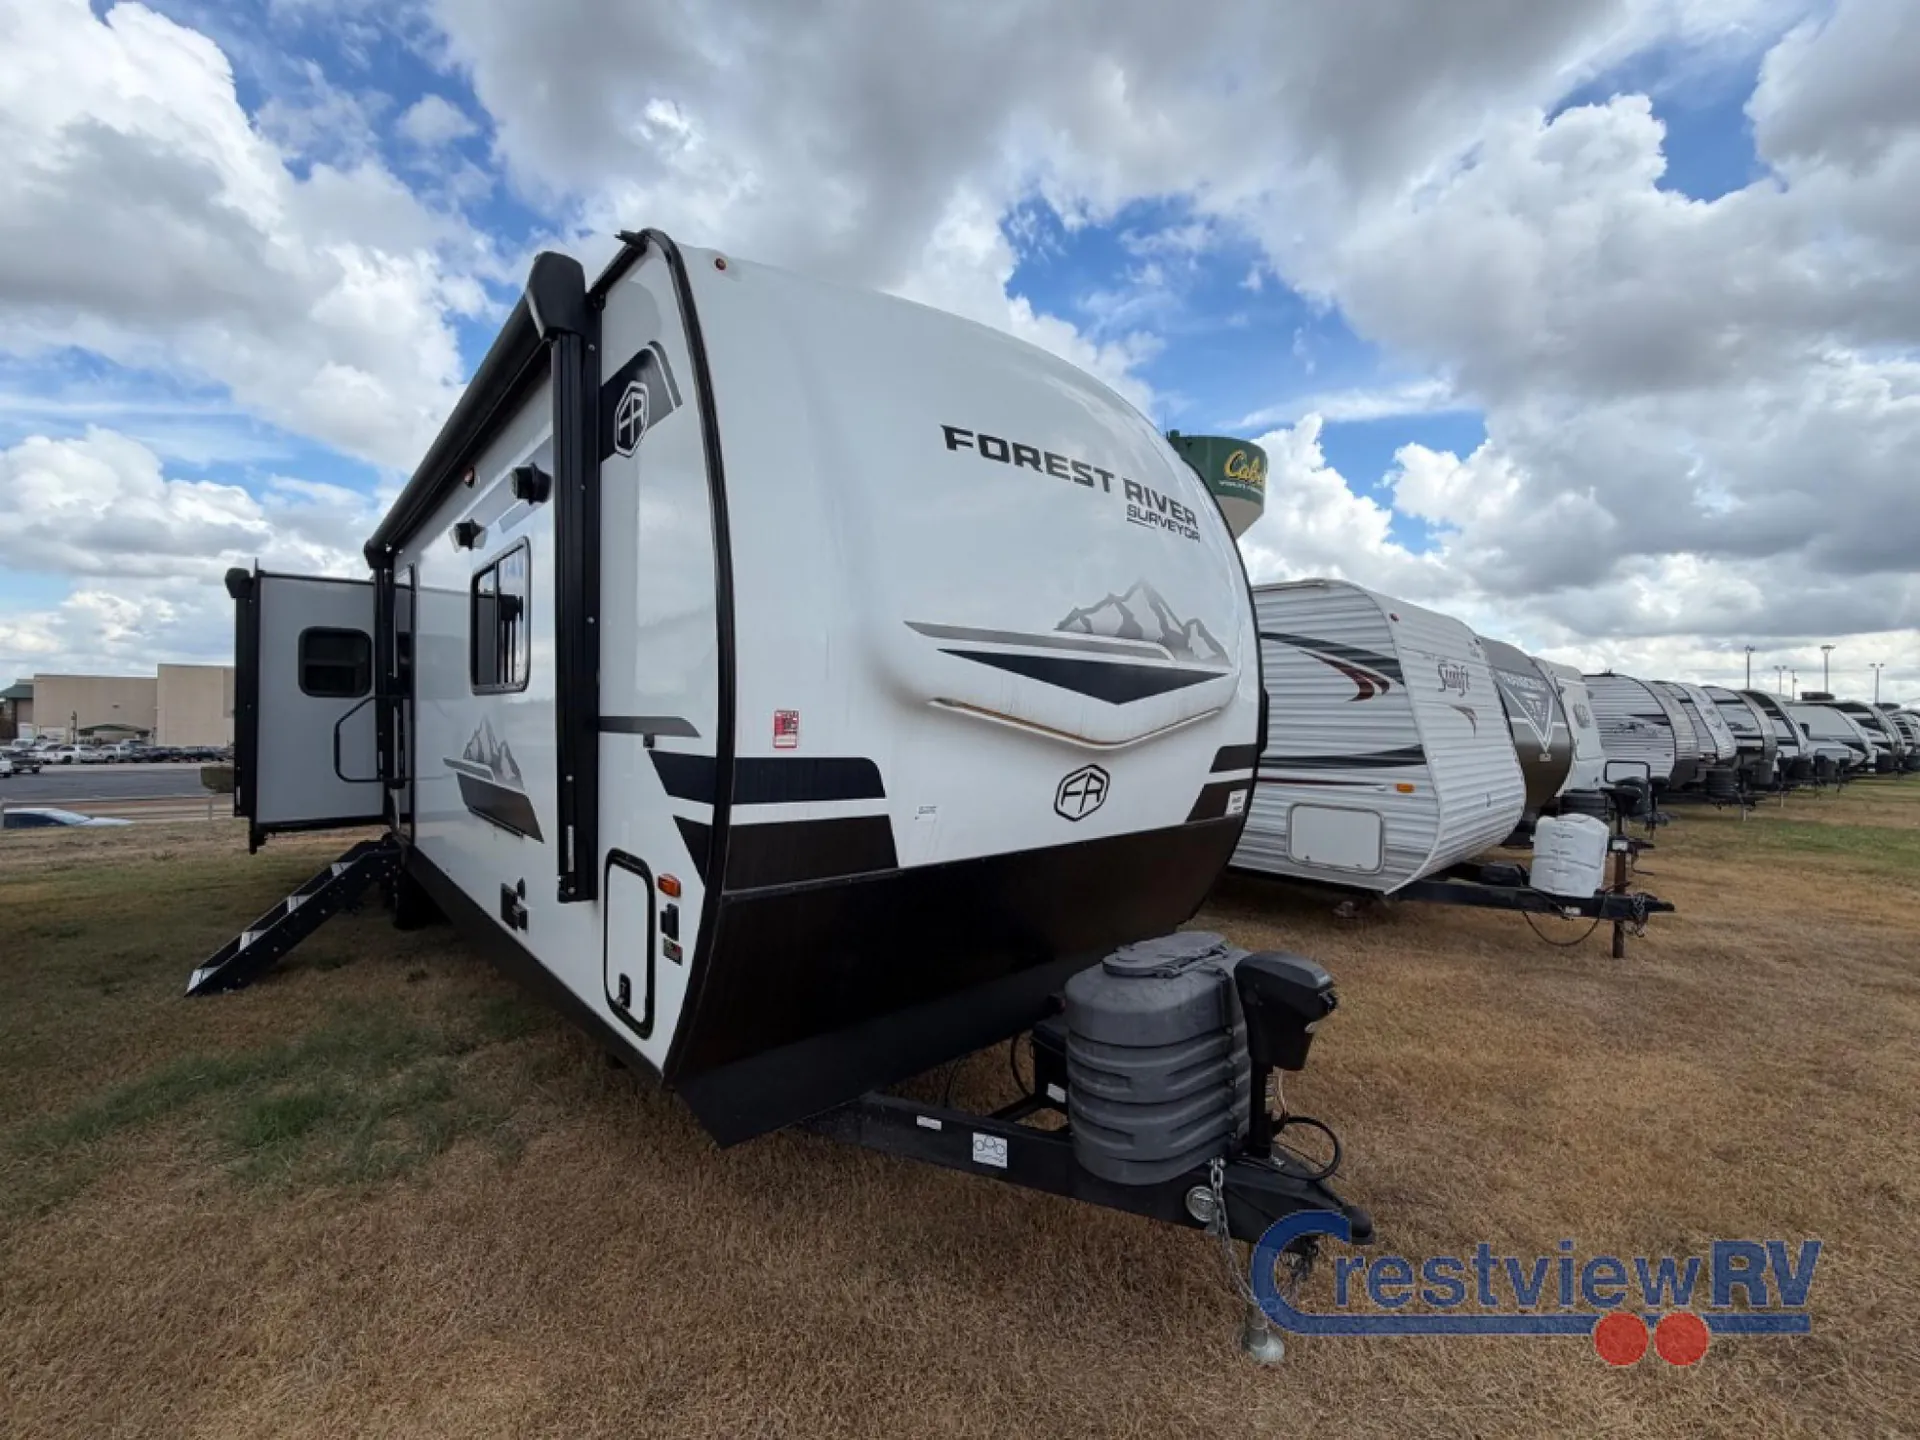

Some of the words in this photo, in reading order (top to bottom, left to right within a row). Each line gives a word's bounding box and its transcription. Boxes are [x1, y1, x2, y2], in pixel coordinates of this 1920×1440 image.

[940, 424, 1115, 493] FOREST
[1123, 477, 1199, 529] RIVER
[1126, 504, 1201, 543] SURVEYOR
